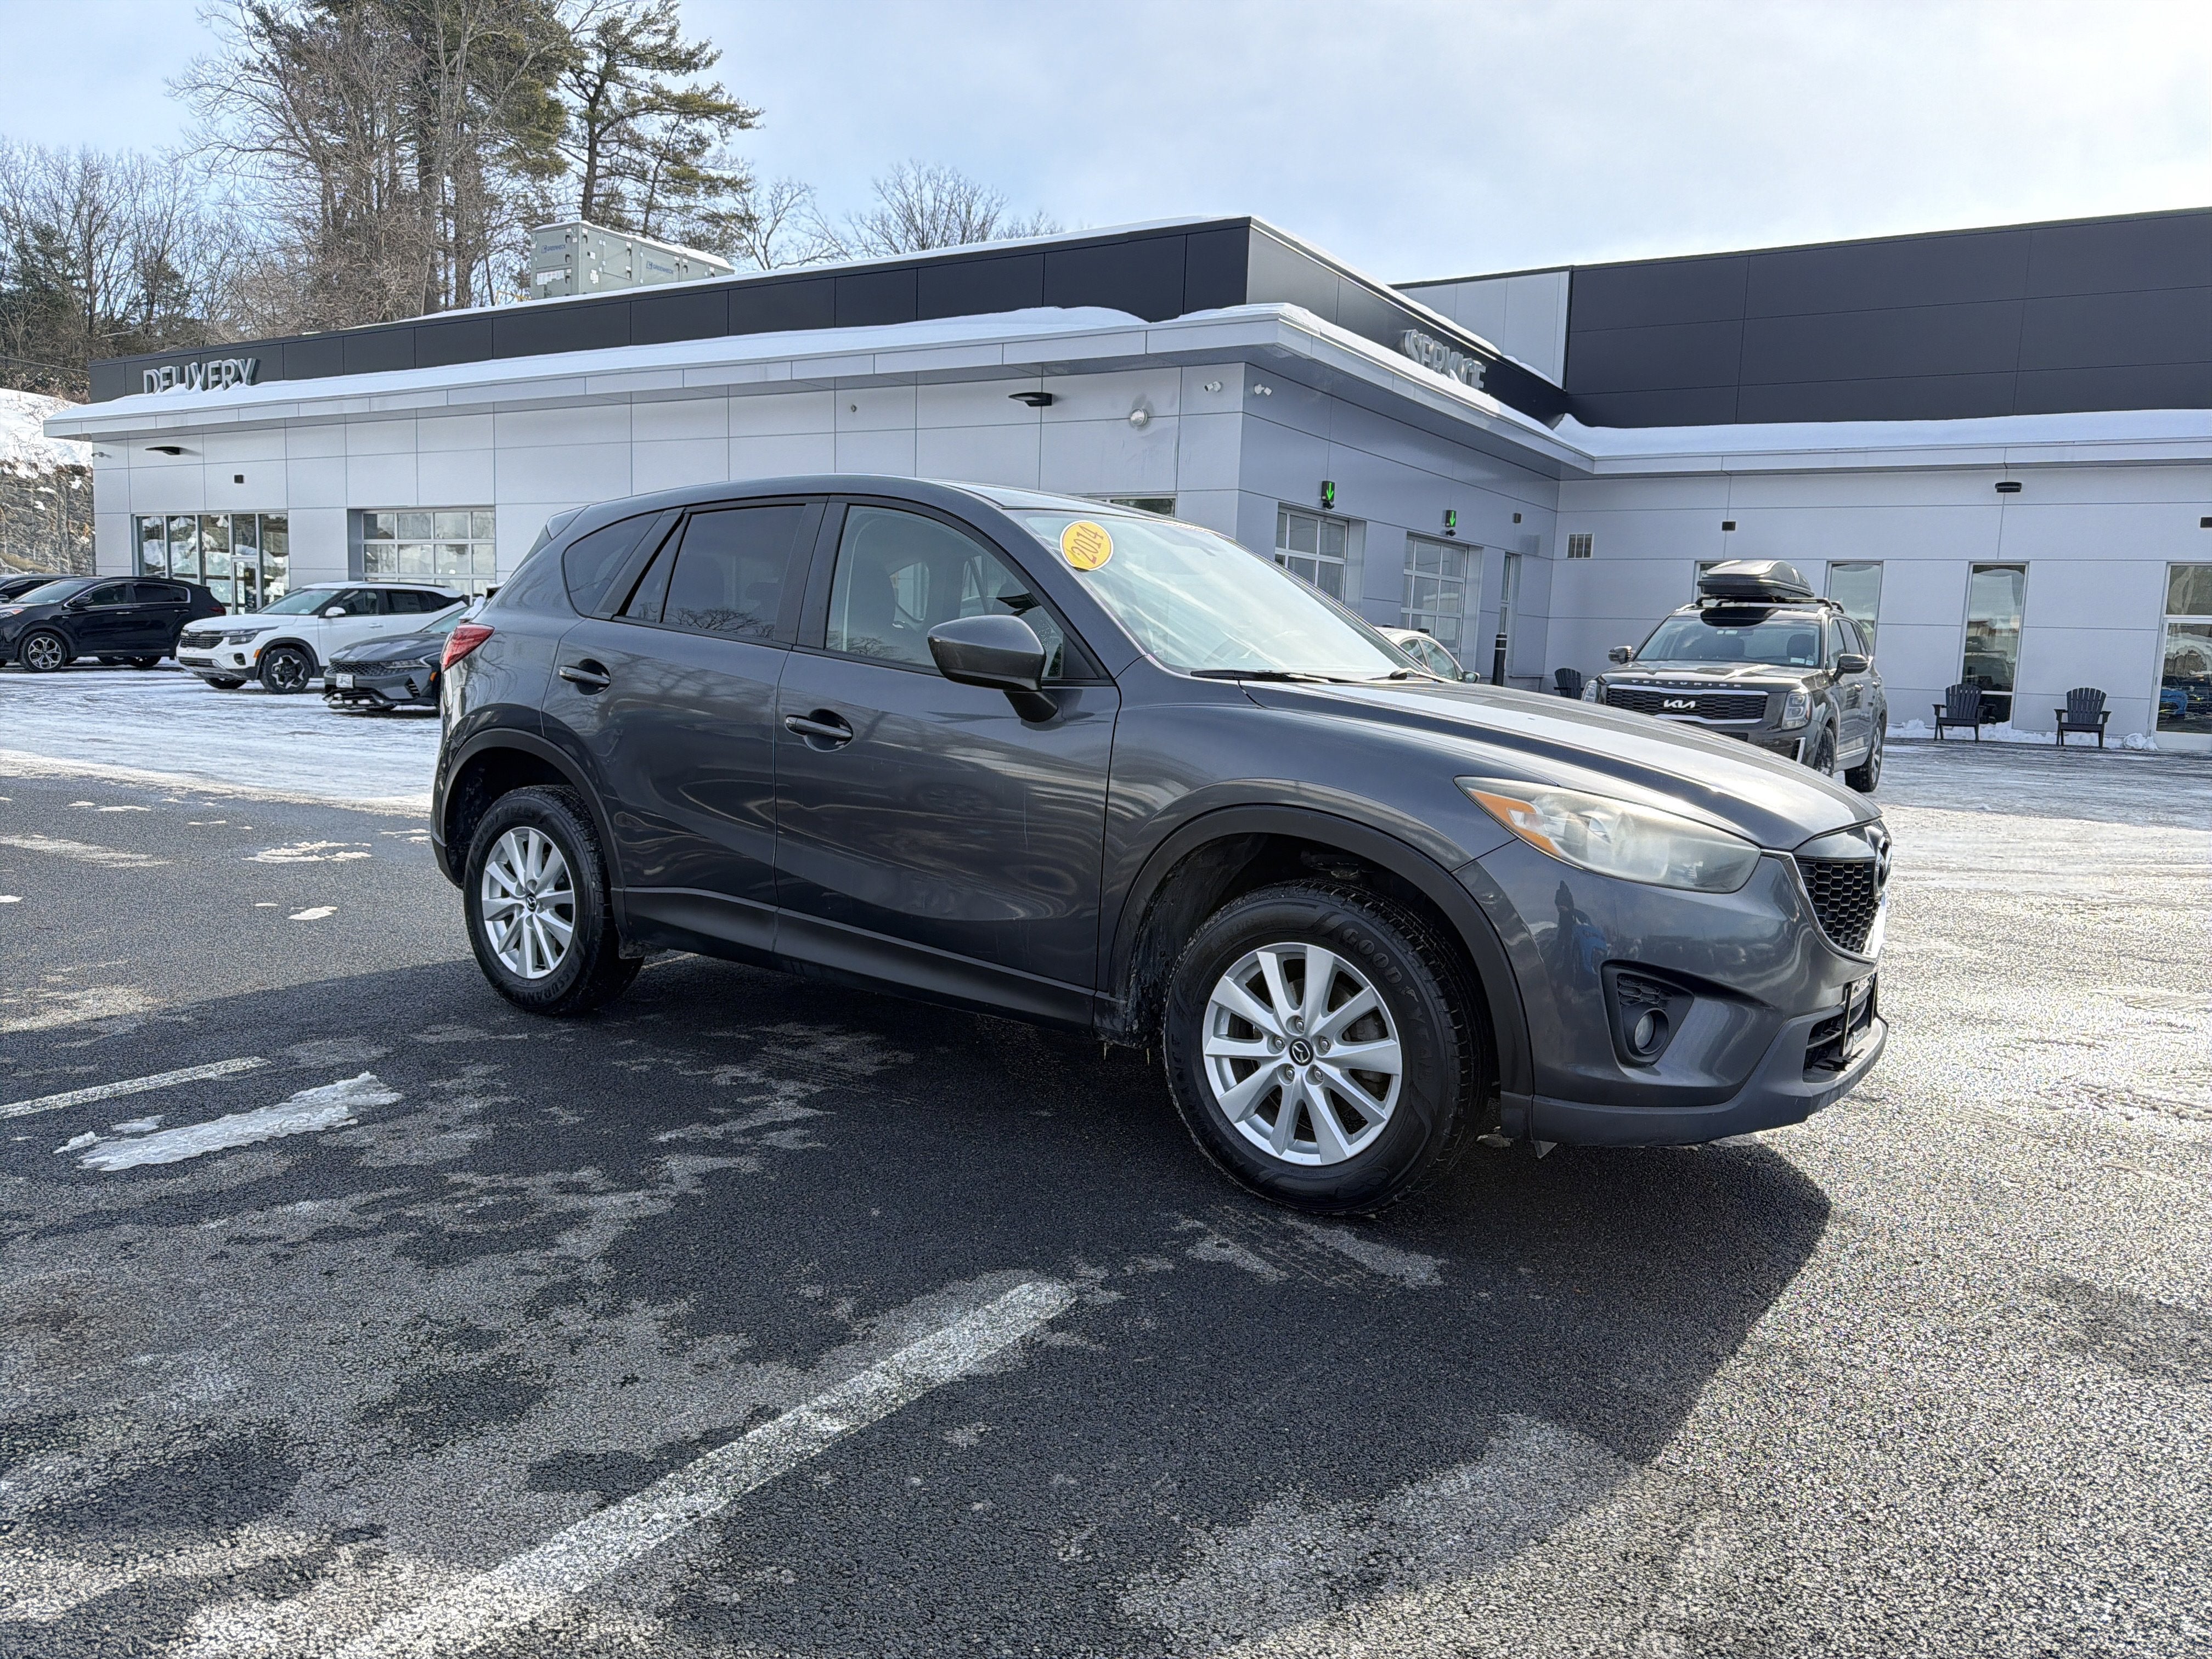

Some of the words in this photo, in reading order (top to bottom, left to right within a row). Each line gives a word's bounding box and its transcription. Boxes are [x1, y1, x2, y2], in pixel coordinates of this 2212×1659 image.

[143, 358, 256, 393] DELIVERY
[1405, 329, 1486, 389] SERVICE
[1070, 524, 1103, 564] 2014
[1663, 699, 1696, 709] KIA
